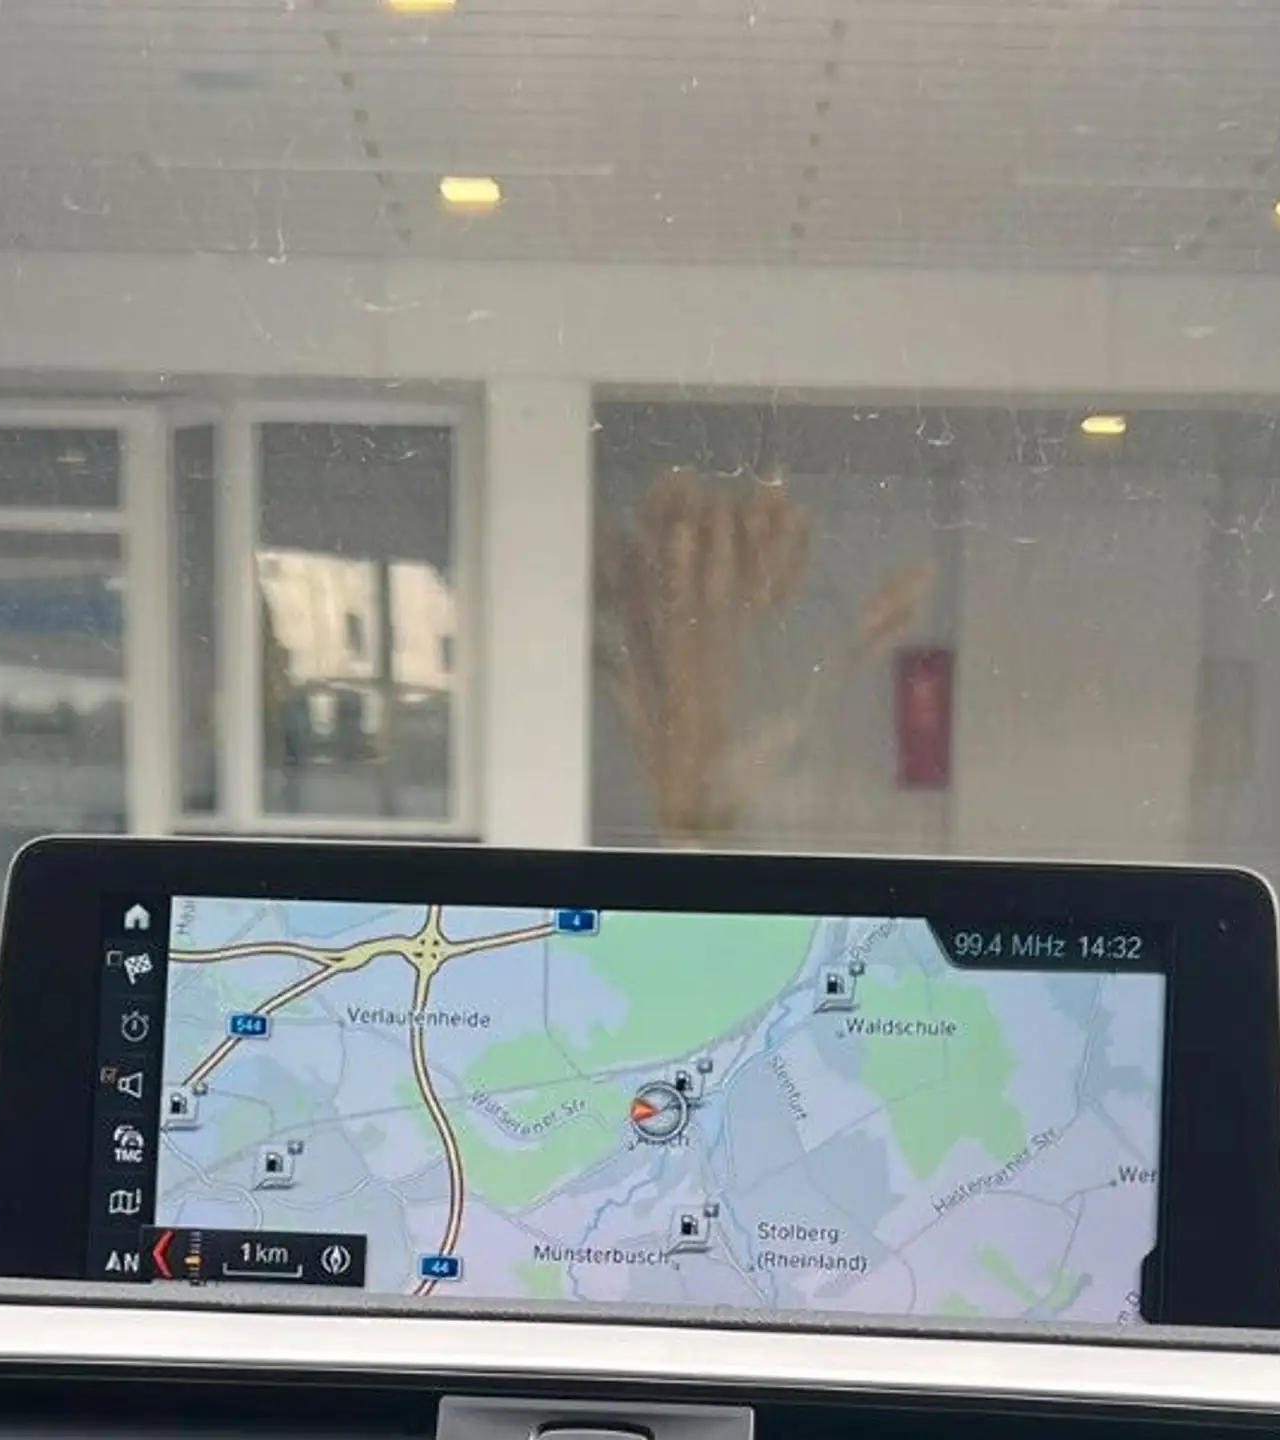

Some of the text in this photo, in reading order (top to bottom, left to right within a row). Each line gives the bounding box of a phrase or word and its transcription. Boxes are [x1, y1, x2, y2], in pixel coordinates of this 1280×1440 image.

[572, 914, 582, 928] 4
[953, 932, 1143, 960] 99.4 MHz 14:32
[346, 1006, 492, 1029] Verlautenheide
[845, 1017, 957, 1038] Waldschule
[114, 1147, 143, 1163] TMC
[756, 1221, 840, 1244] Stolberg
[240, 1241, 289, 1264] 1 km
[431, 1259, 450, 1274] 44
[756, 1253, 869, 1274] (Rheinland)
